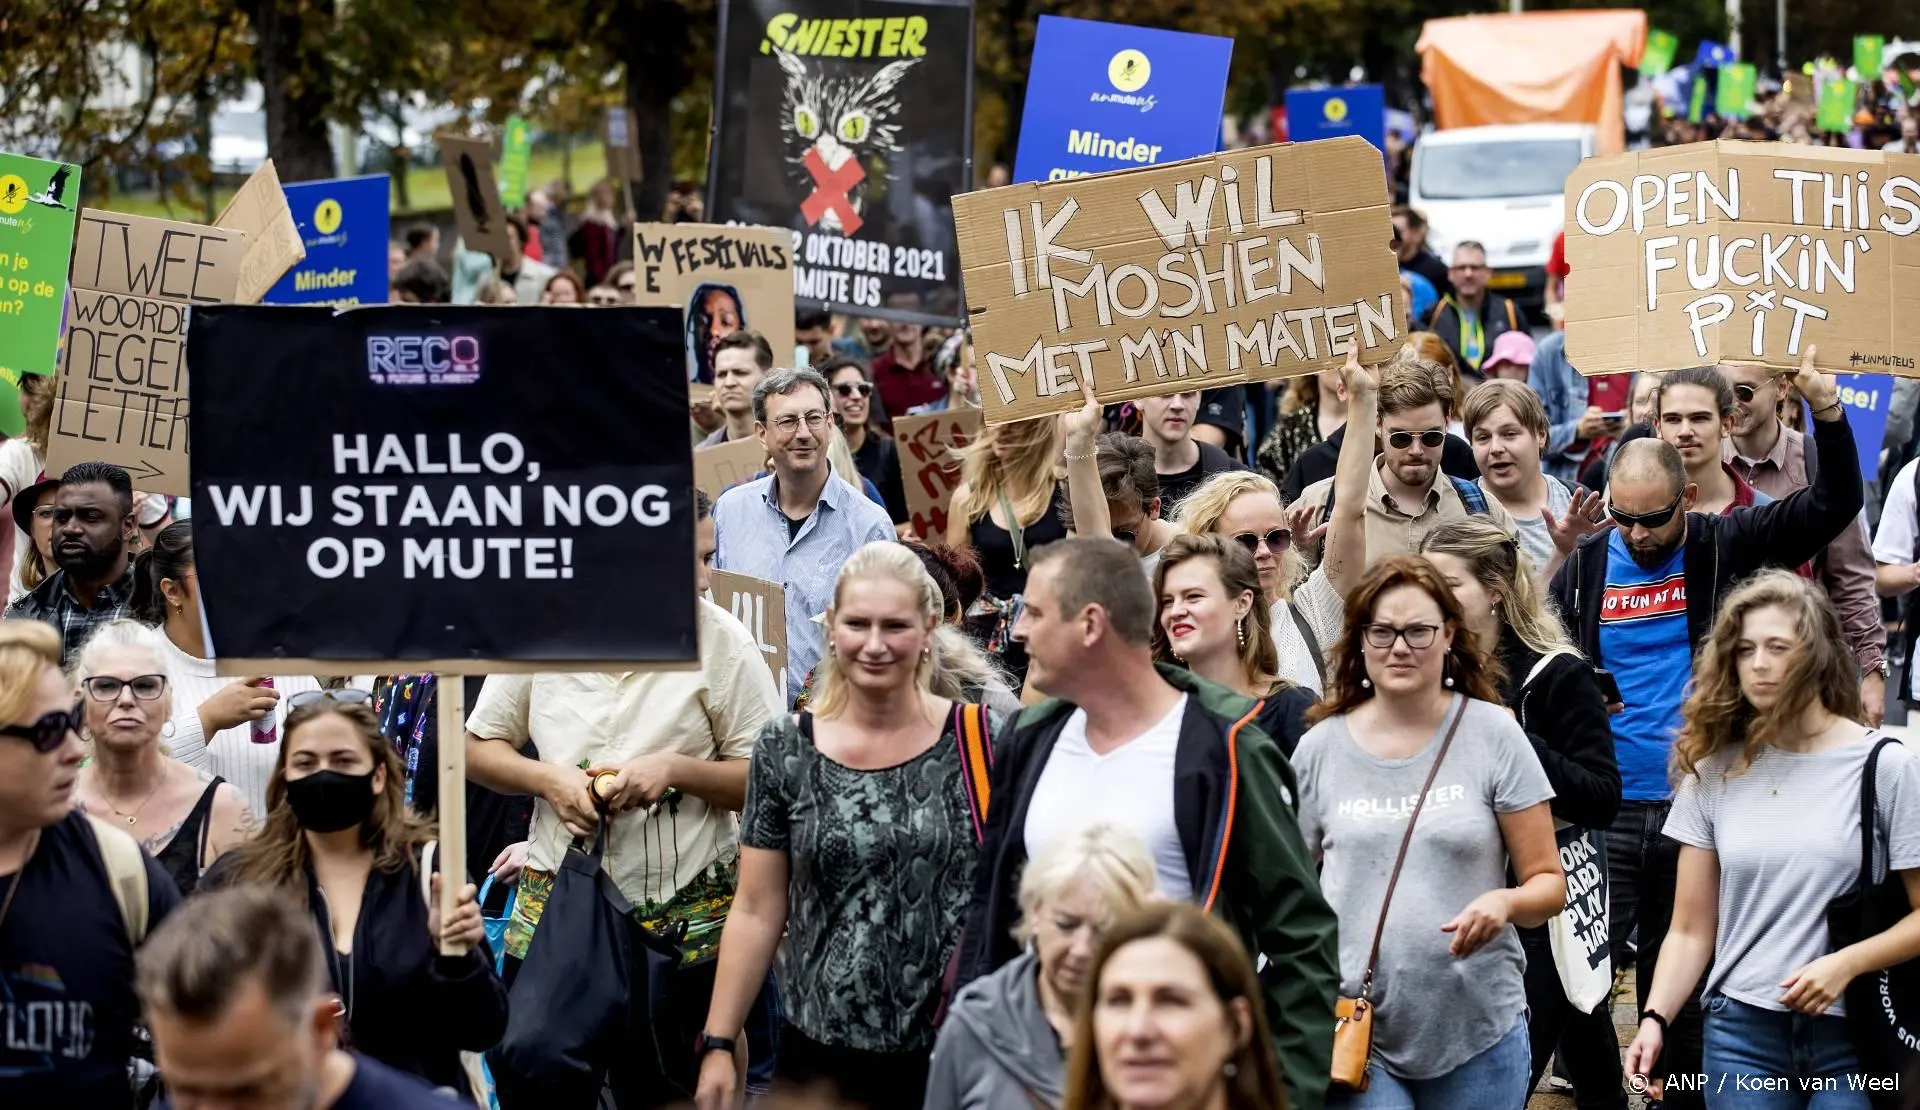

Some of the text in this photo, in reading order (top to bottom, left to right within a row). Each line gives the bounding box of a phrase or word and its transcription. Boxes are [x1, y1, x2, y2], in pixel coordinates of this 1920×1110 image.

[760, 13, 928, 57] SNIESTER
[1067, 130, 1162, 163] Minder
[1575, 167, 1740, 236] OPEN
[12, 252, 28, 271] je
[83, 217, 228, 303] TWEE
[670, 234, 787, 275] FESTIVALS
[806, 233, 889, 274] OKTOBER
[894, 246, 946, 281] 2021
[1003, 197, 1094, 296] IK
[8, 277, 29, 296] op
[34, 280, 55, 298] de
[295, 268, 357, 292] Minder
[853, 275, 882, 308] US
[1052, 233, 1324, 333] MOSHEN
[984, 294, 1398, 404] MET M'N MATEN
[332, 433, 540, 482] HALLO,
[208, 484, 671, 528] WIJ STAAN NOG
[306, 537, 574, 580] OP MUTE!
[1621, 594, 1650, 610] FUN
[1653, 589, 1669, 605] AT
[1338, 784, 1465, 816] HOLLISTER
[1560, 831, 1598, 872] ORK
